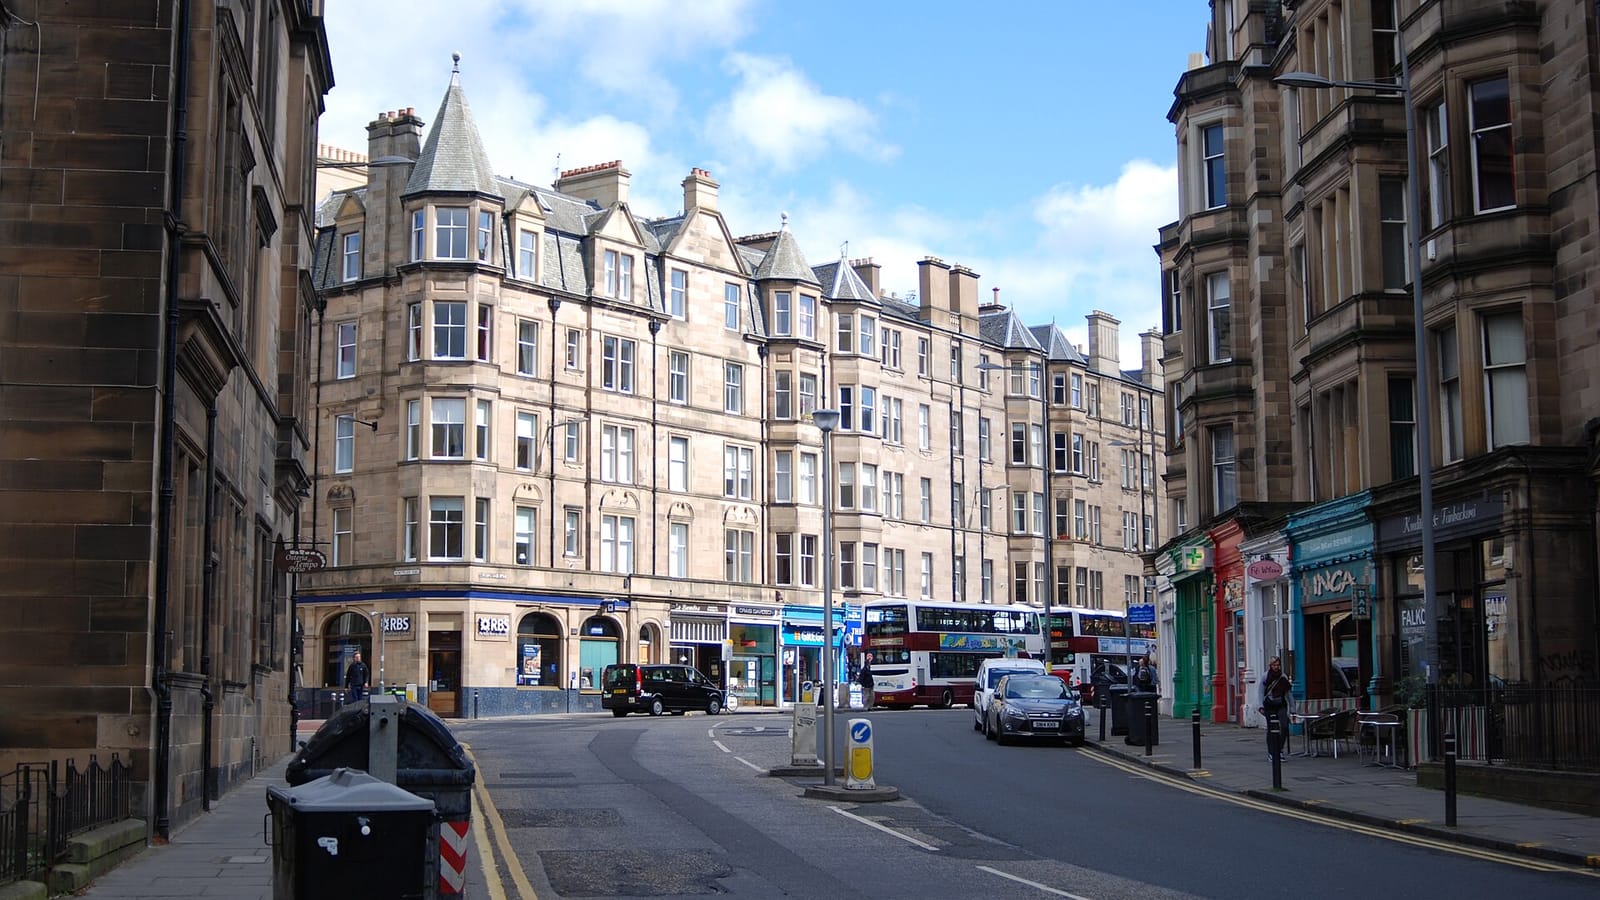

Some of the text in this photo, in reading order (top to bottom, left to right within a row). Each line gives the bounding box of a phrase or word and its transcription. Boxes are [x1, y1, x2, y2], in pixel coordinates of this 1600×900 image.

[285, 554, 308, 562] Osteria
[294, 560, 318, 570] Tempo
[1313, 569, 1356, 595] INCA
[1358, 590, 1367, 614] BAR
[1484, 597, 1508, 616] FALK
[390, 617, 409, 630] RBS
[491, 617, 510, 631] RBS
[801, 631, 825, 642] GREGG
